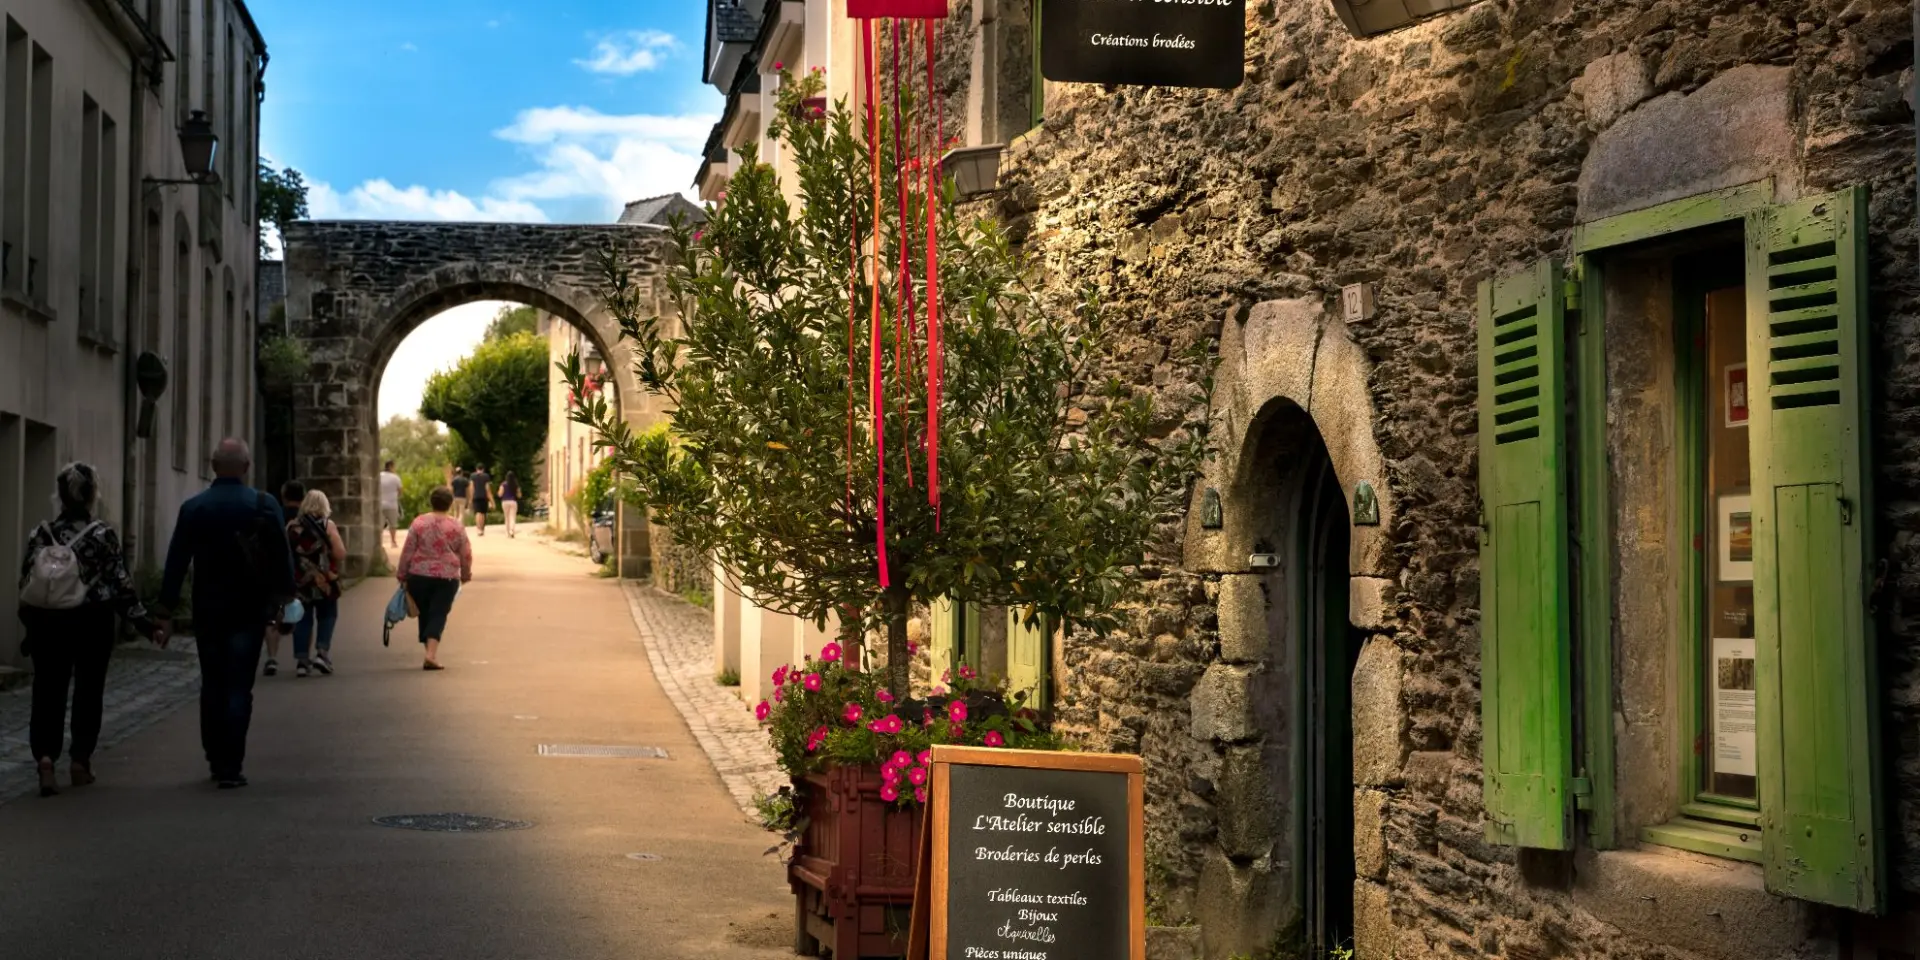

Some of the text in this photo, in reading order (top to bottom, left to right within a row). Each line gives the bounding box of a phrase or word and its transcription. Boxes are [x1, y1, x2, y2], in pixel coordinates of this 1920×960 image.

[1091, 33, 1196, 49] Créations brodées
[1347, 291, 1358, 314] 12
[1003, 793, 1076, 817] Boutique
[972, 813, 1106, 835] L'Atelier sensible
[975, 845, 1102, 870] Broderies de perles
[987, 888, 1088, 905] Tableaux textiles
[1018, 909, 1058, 926] Bijoux
[997, 918, 1056, 944] Aquarelles
[965, 947, 1047, 960] Pièces uniques
